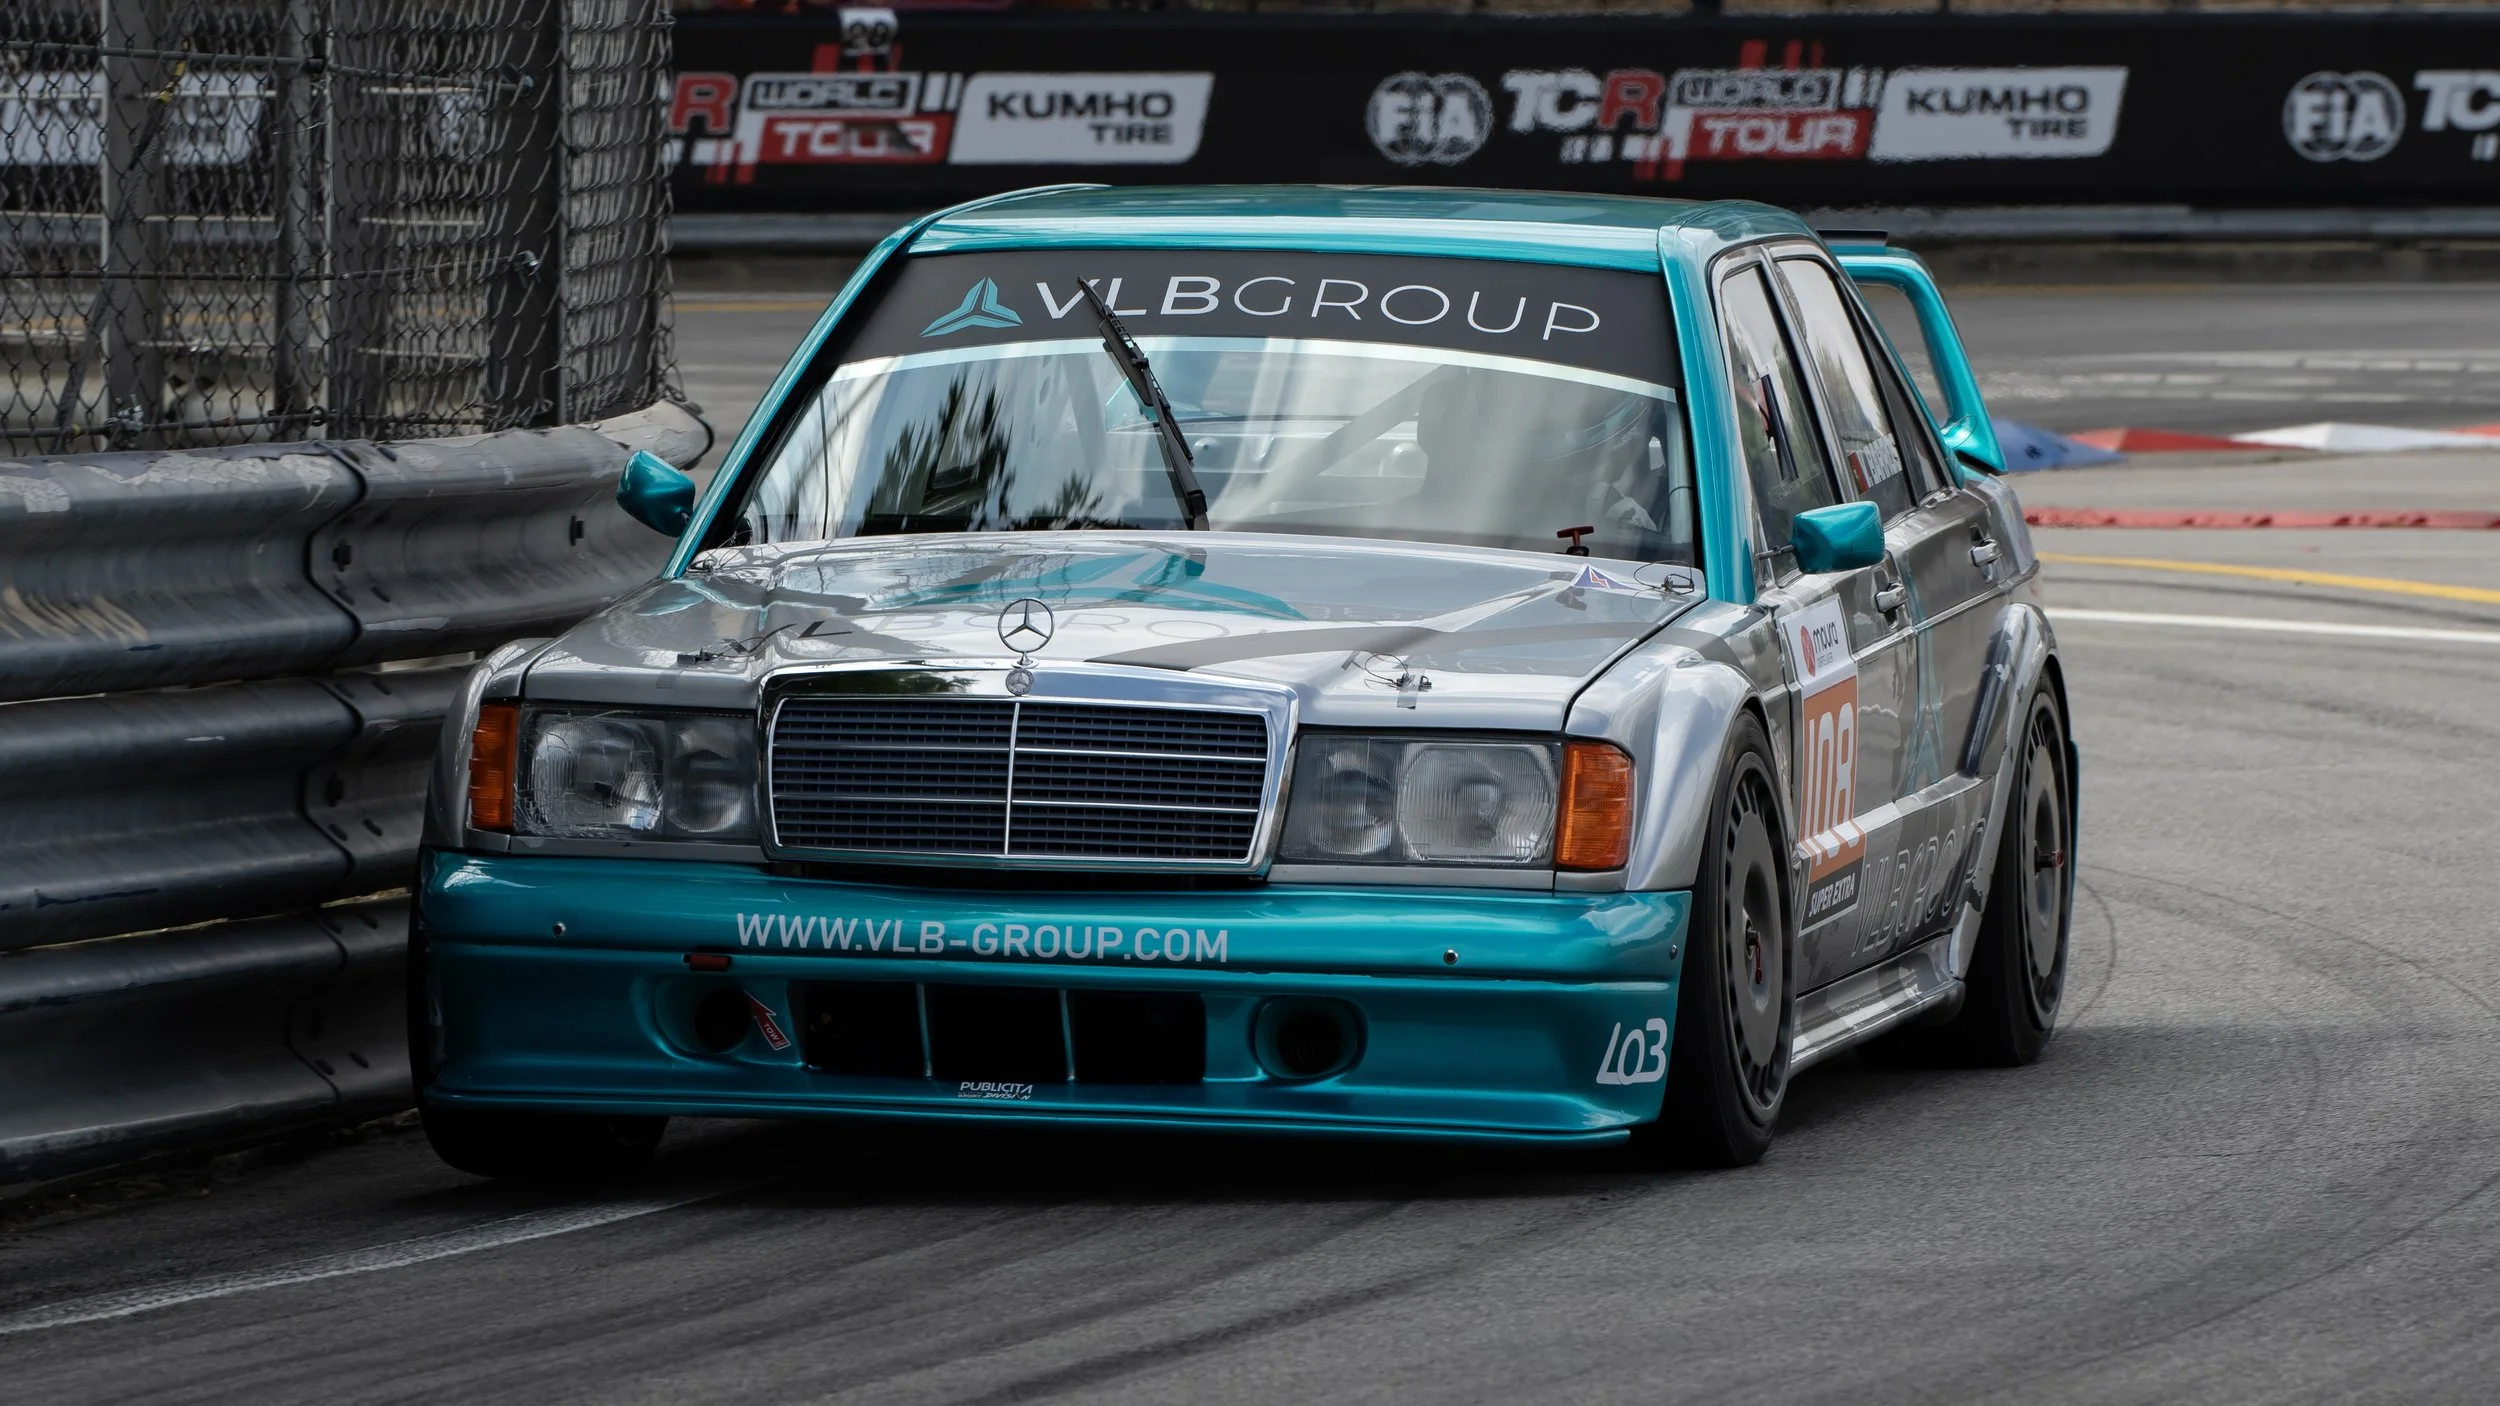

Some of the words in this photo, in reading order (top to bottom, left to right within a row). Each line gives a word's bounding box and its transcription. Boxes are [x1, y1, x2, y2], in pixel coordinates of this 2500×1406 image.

[988, 91, 1175, 119] KUMHO
[1379, 94, 1476, 141] FIA
[1502, 69, 1666, 131] TCR
[1908, 85, 2090, 115] KUMHO
[2291, 90, 2386, 139] FIA
[1088, 123, 1173, 144] TIRE
[1703, 116, 1858, 154] TOUR
[2006, 118, 2087, 139] TIRE
[1035, 276, 1600, 342] VLBGROUP
[1812, 621, 1839, 654] moura
[1804, 702, 1861, 866] 108
[1808, 881, 1834, 917] SUPER
[1832, 873, 1856, 908] EXTRA
[736, 912, 1229, 963] WWW.VLB-GROUP.COM
[764, 1023, 780, 1040] TOW
